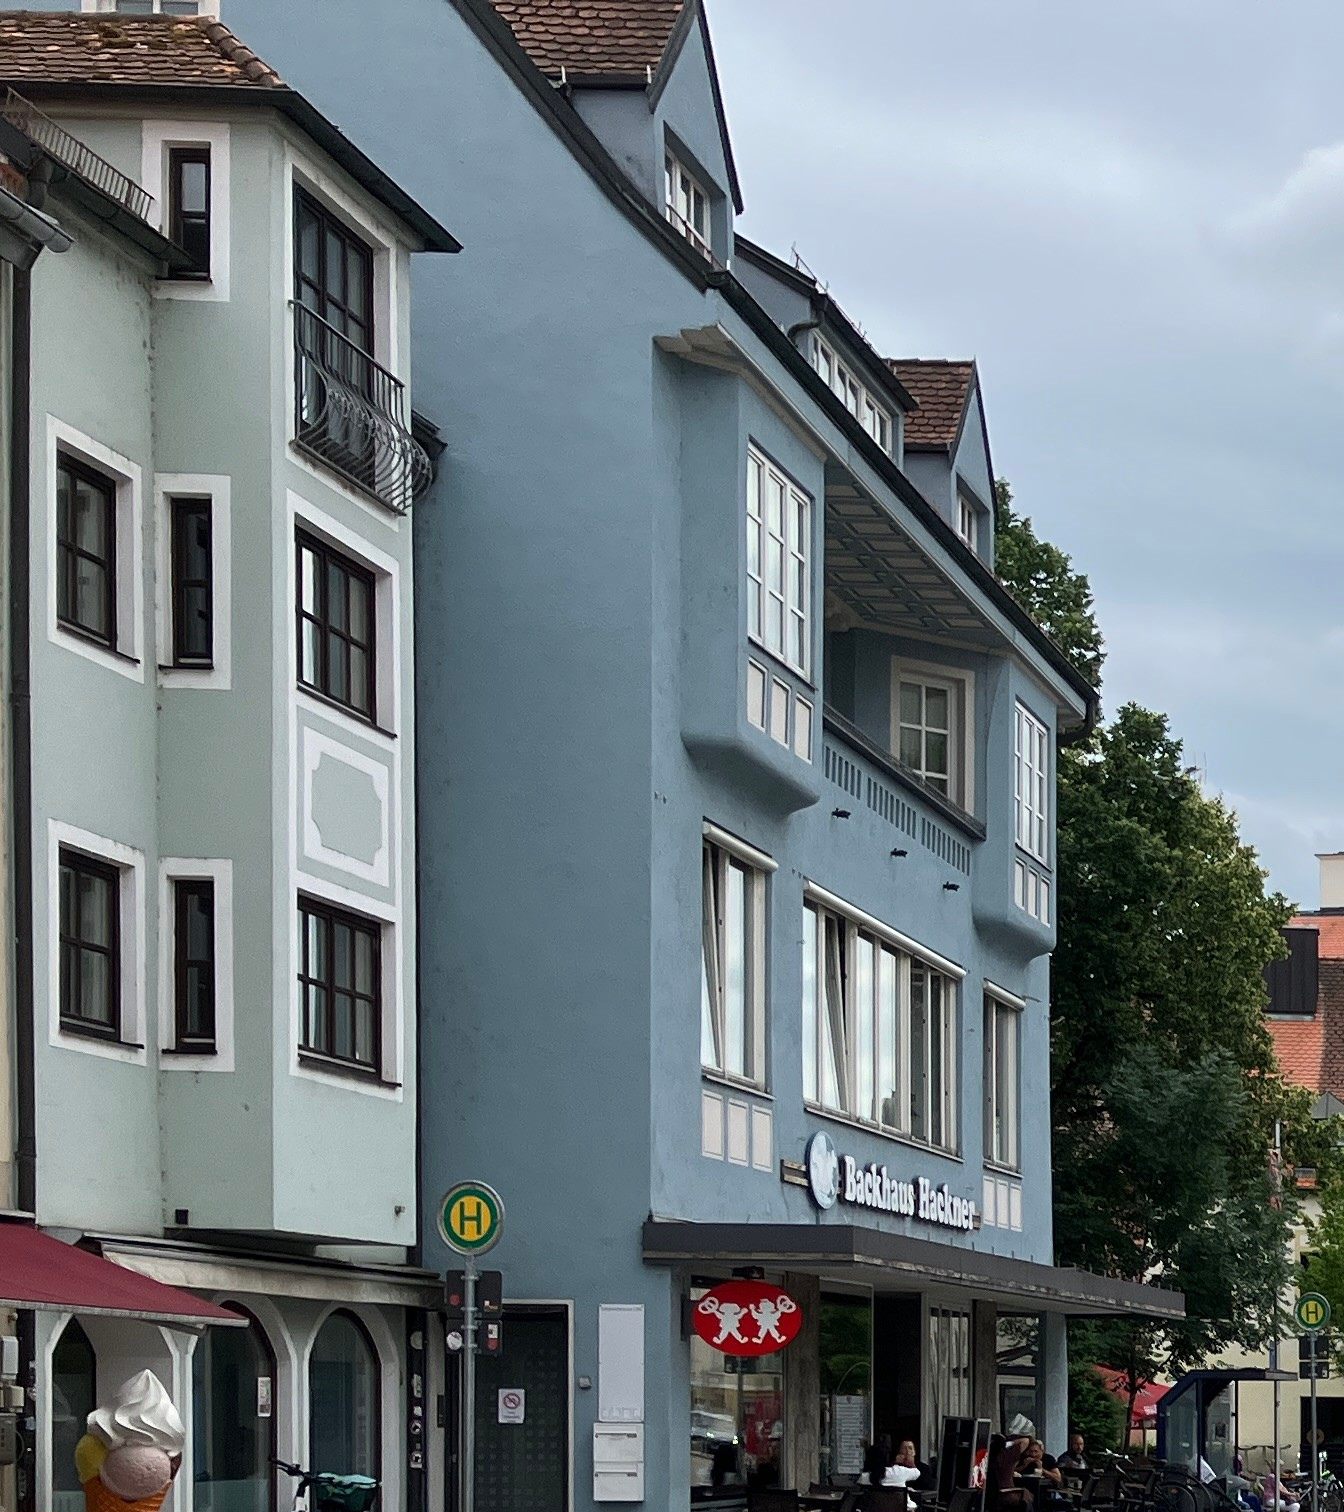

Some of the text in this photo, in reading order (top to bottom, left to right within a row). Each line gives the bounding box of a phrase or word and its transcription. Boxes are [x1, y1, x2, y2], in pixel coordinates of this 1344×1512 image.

[843, 1155, 976, 1230] Backhaus Hackner
[459, 1201, 482, 1236] H
[1305, 1303, 1319, 1322] H
